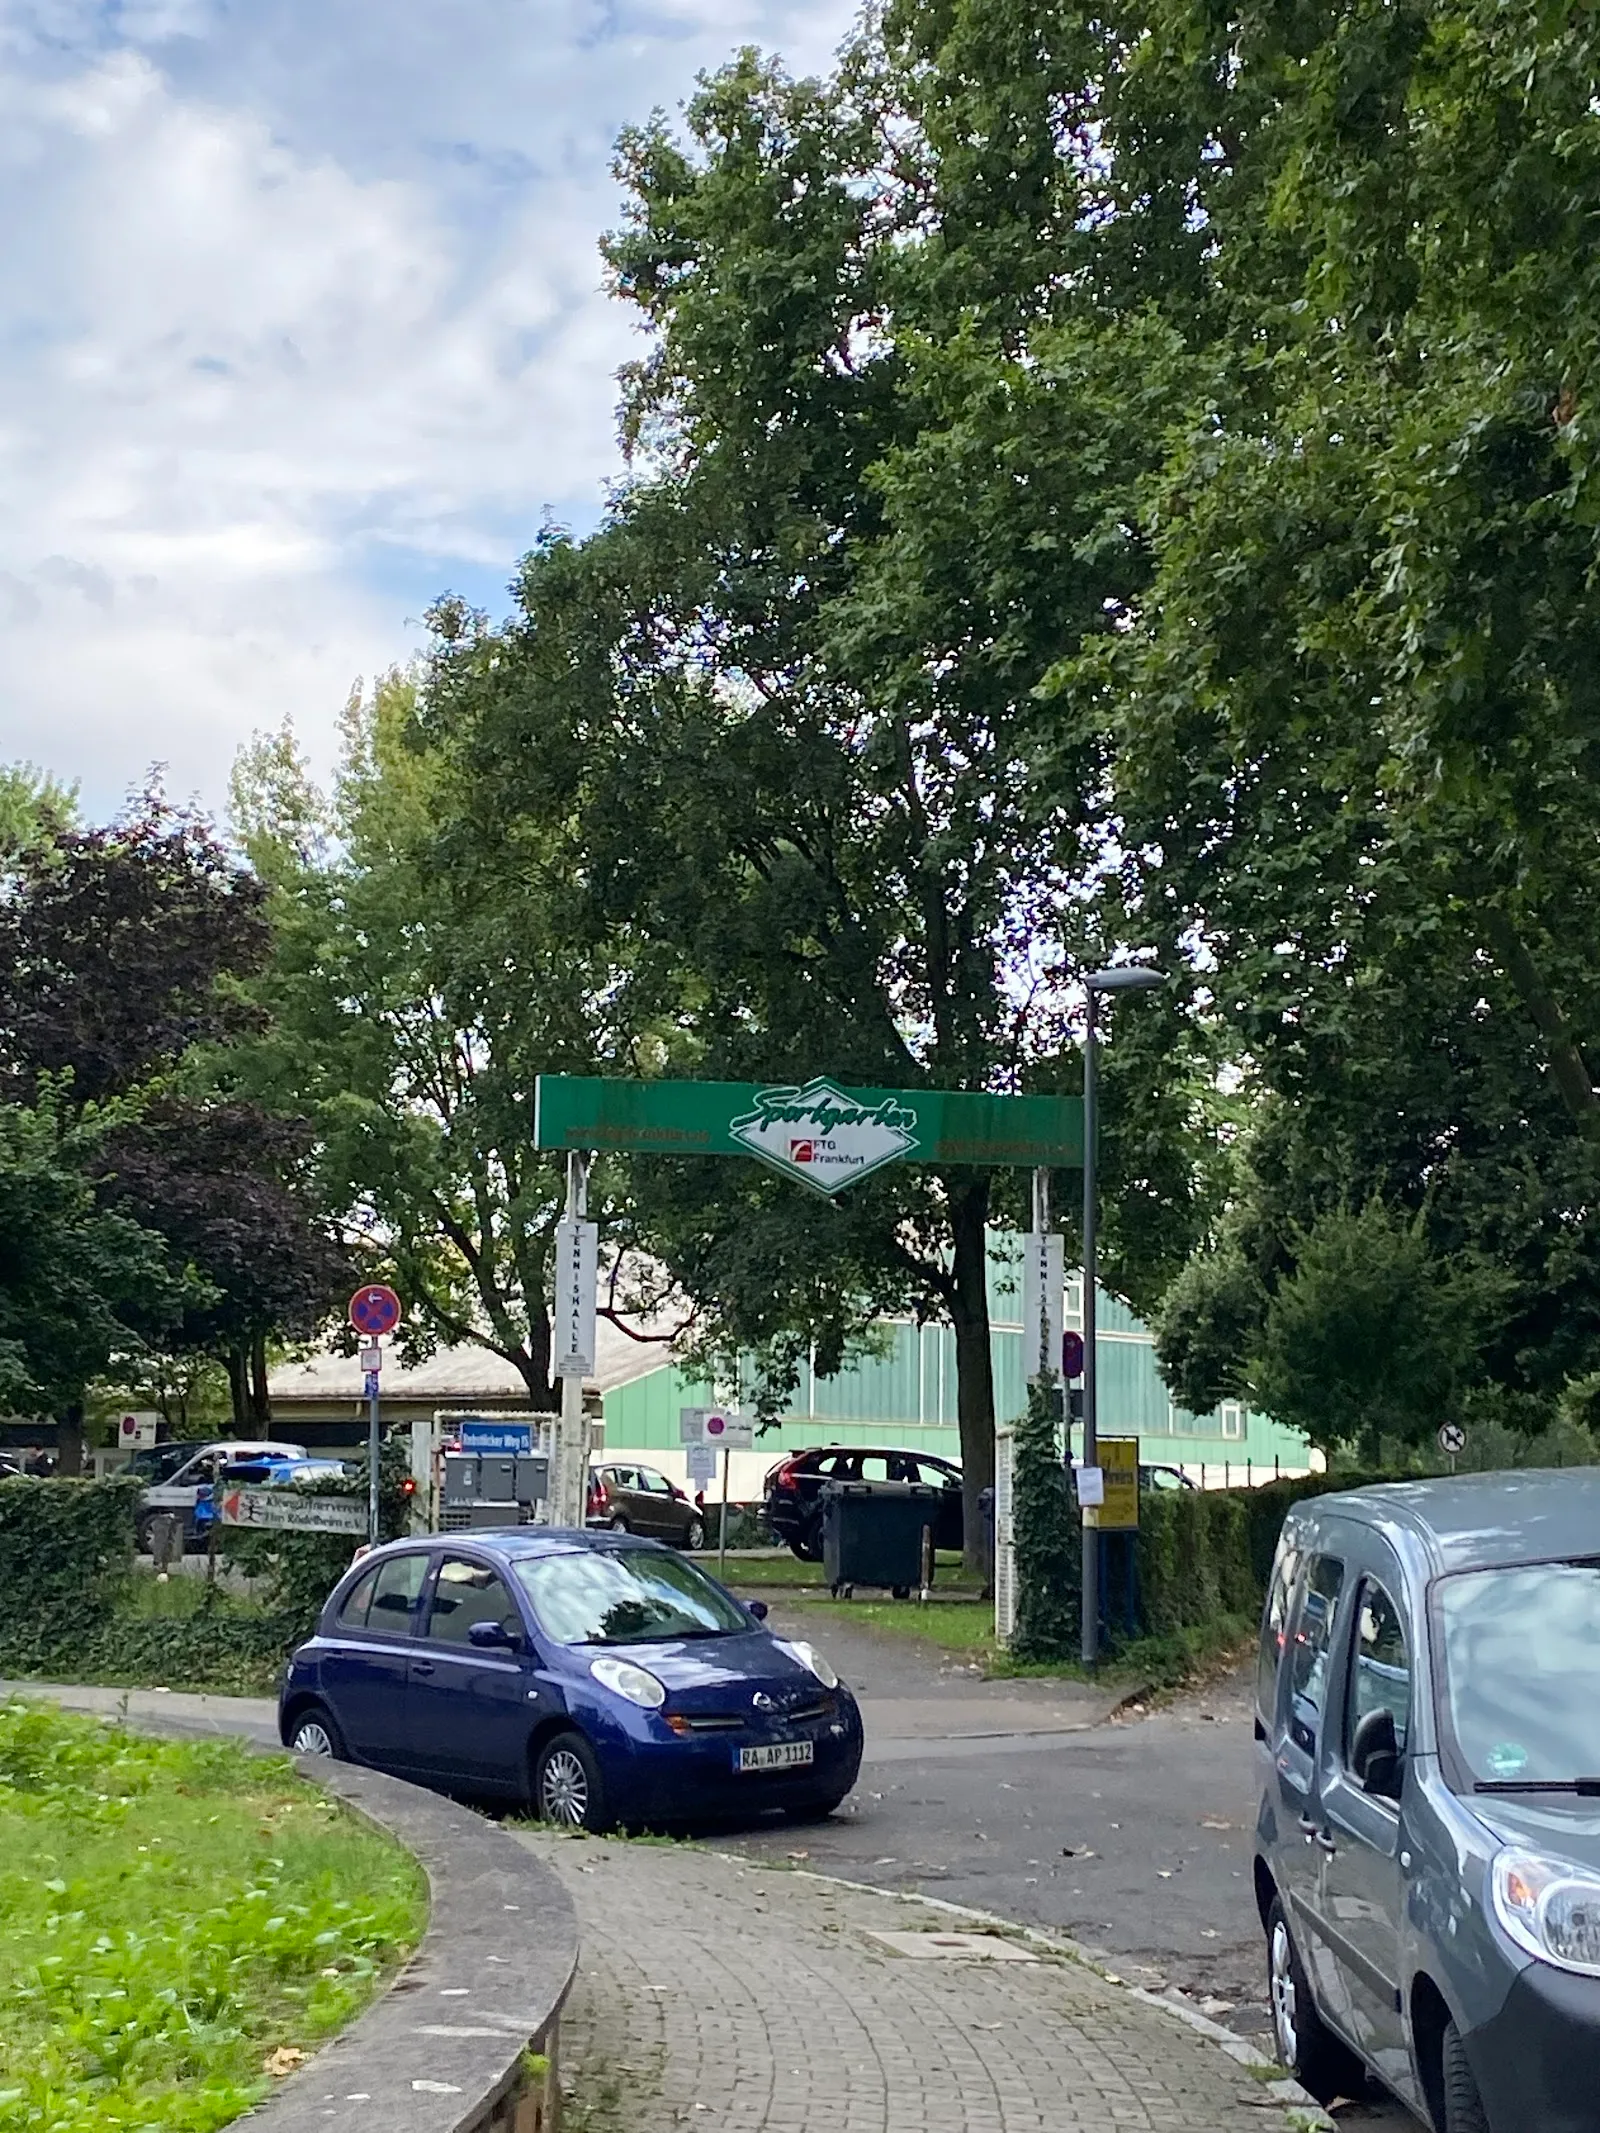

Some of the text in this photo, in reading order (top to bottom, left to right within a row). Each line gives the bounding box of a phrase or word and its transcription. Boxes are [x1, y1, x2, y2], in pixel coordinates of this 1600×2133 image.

[730, 1086, 917, 1136] Sportgarten
[813, 1139, 837, 1150] FTG
[813, 1153, 865, 1165] Frankfurt
[571, 1225, 581, 1354] TENNISHALLE
[742, 1743, 812, 1767] RA AP 1112
